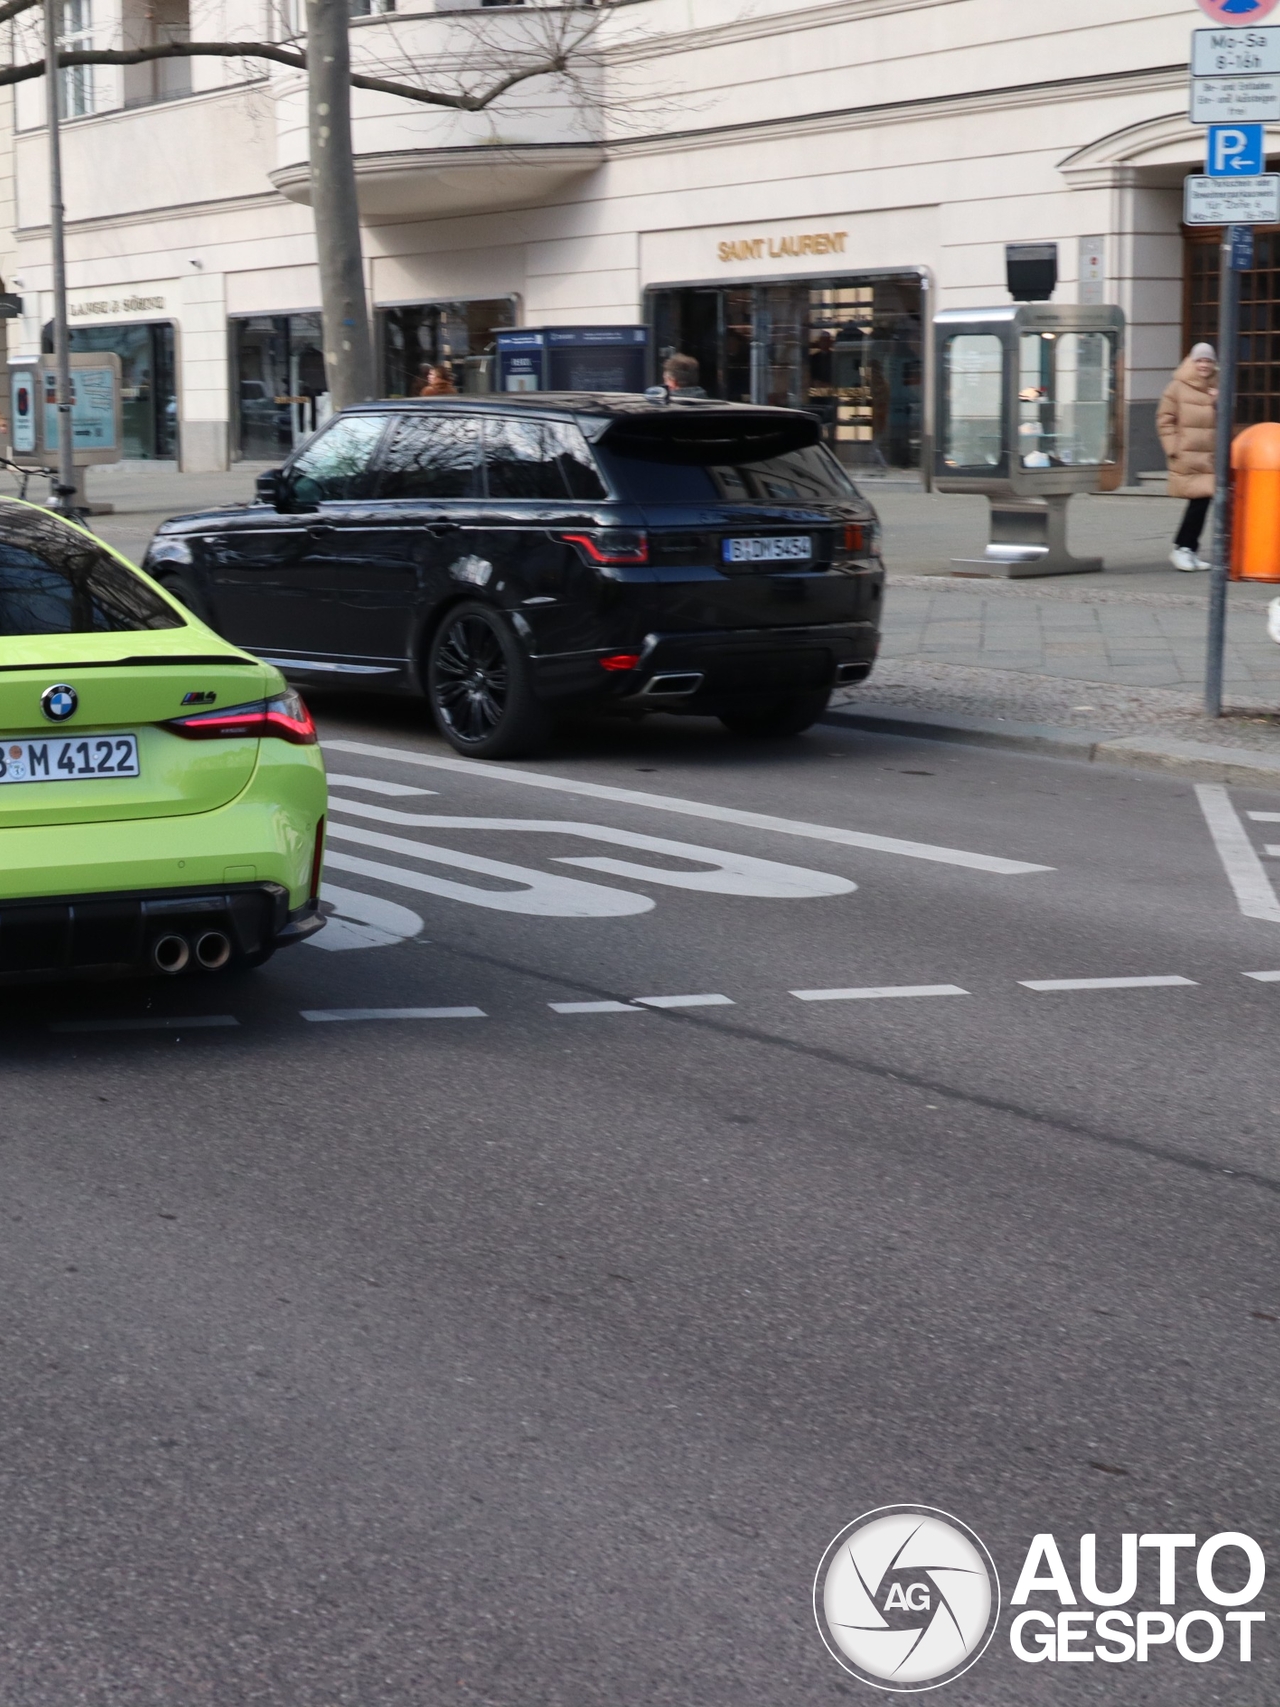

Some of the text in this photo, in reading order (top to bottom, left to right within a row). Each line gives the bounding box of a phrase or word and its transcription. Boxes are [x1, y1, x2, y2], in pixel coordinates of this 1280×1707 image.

[1210, 33, 1268, 49] Mo-Sa
[1214, 129, 1248, 171] P
[717, 231, 849, 262] SAINT LAURENT
[28, 743, 50, 776] M
[57, 740, 135, 774] 4122
